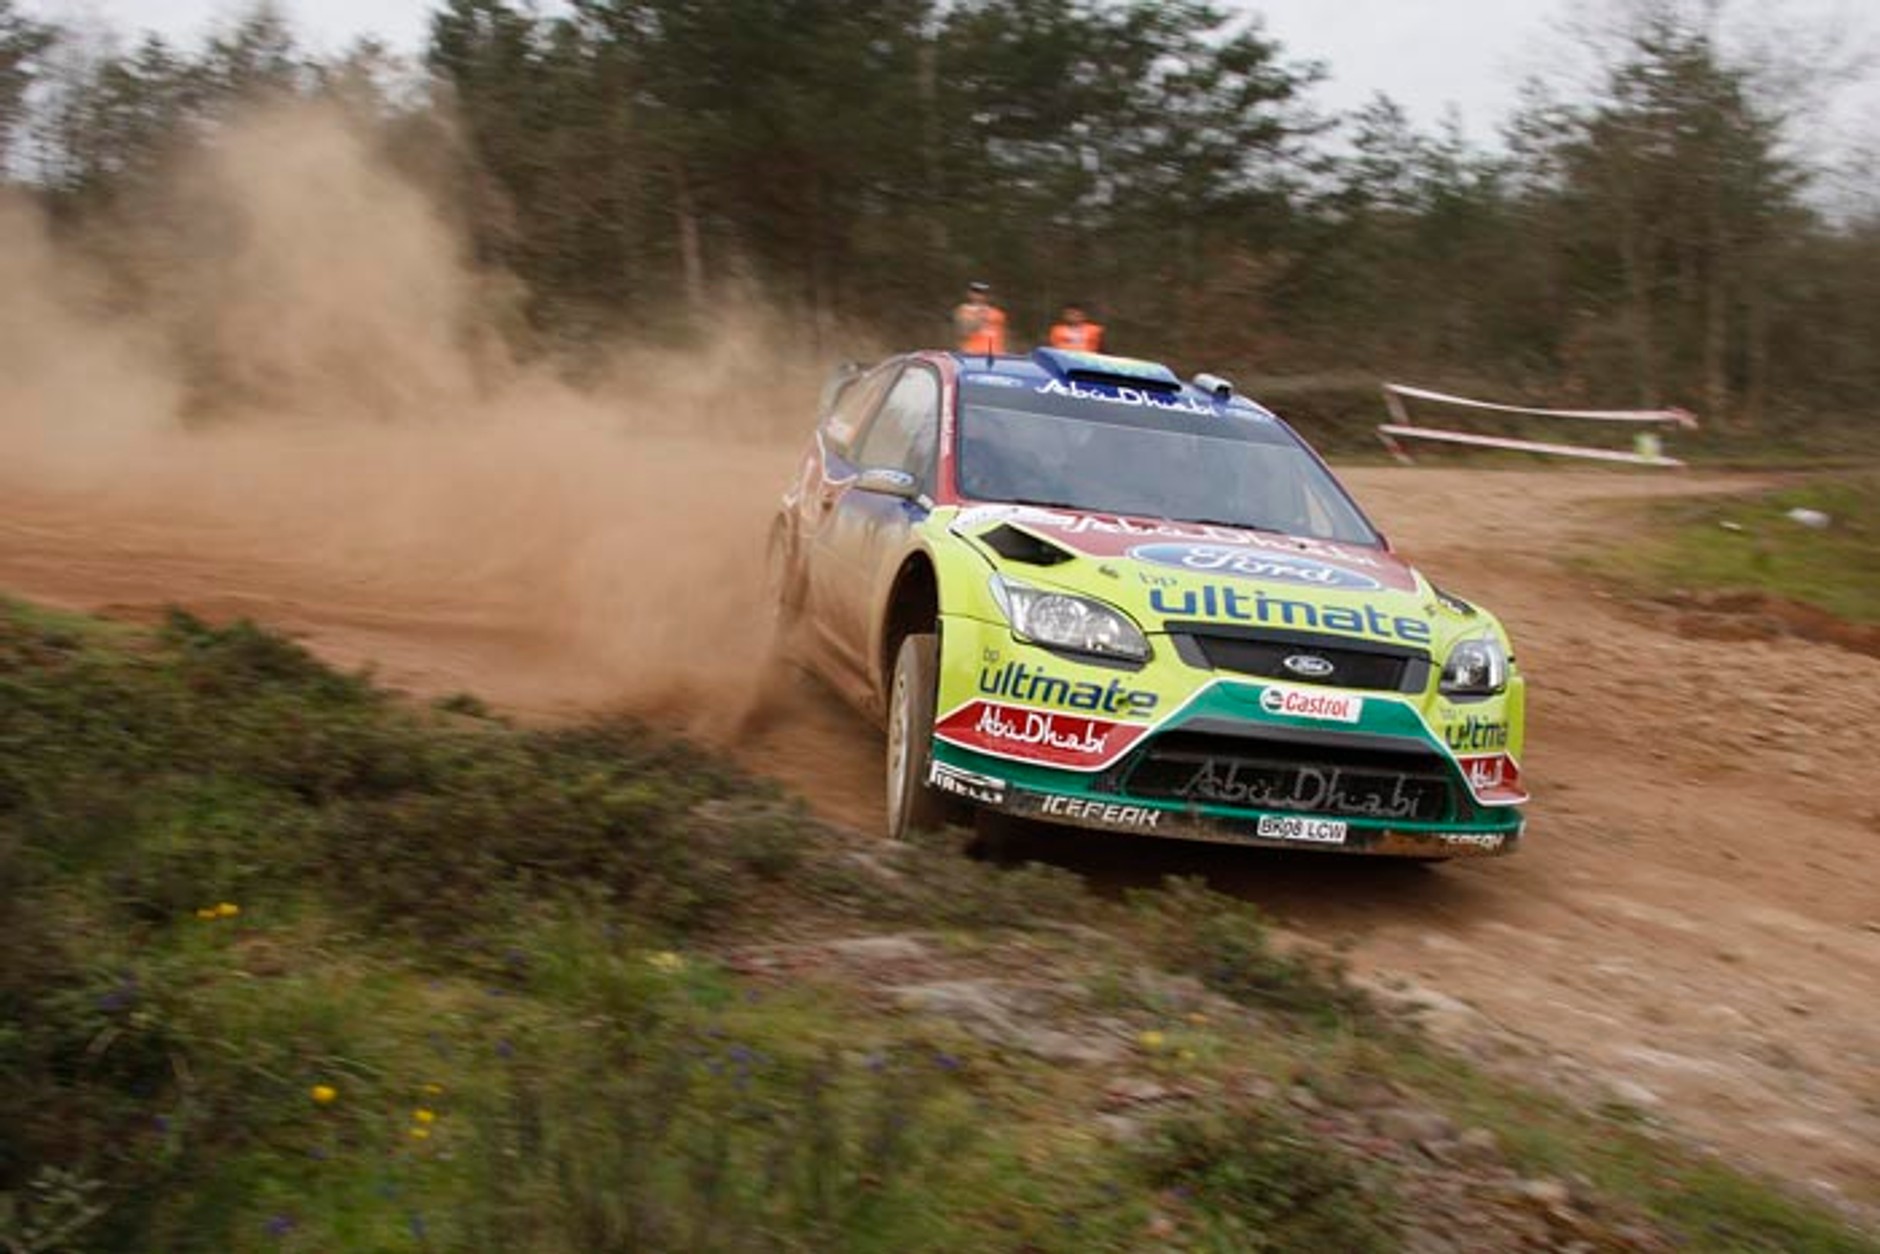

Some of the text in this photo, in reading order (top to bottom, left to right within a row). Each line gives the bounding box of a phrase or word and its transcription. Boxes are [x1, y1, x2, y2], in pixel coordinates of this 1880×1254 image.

[1182, 546, 1341, 586] Ford
[1148, 585, 1434, 645] ultimate
[978, 660, 1159, 718] ultimate
[1286, 691, 1350, 718] Castrol
[1307, 822, 1345, 840] LCW
